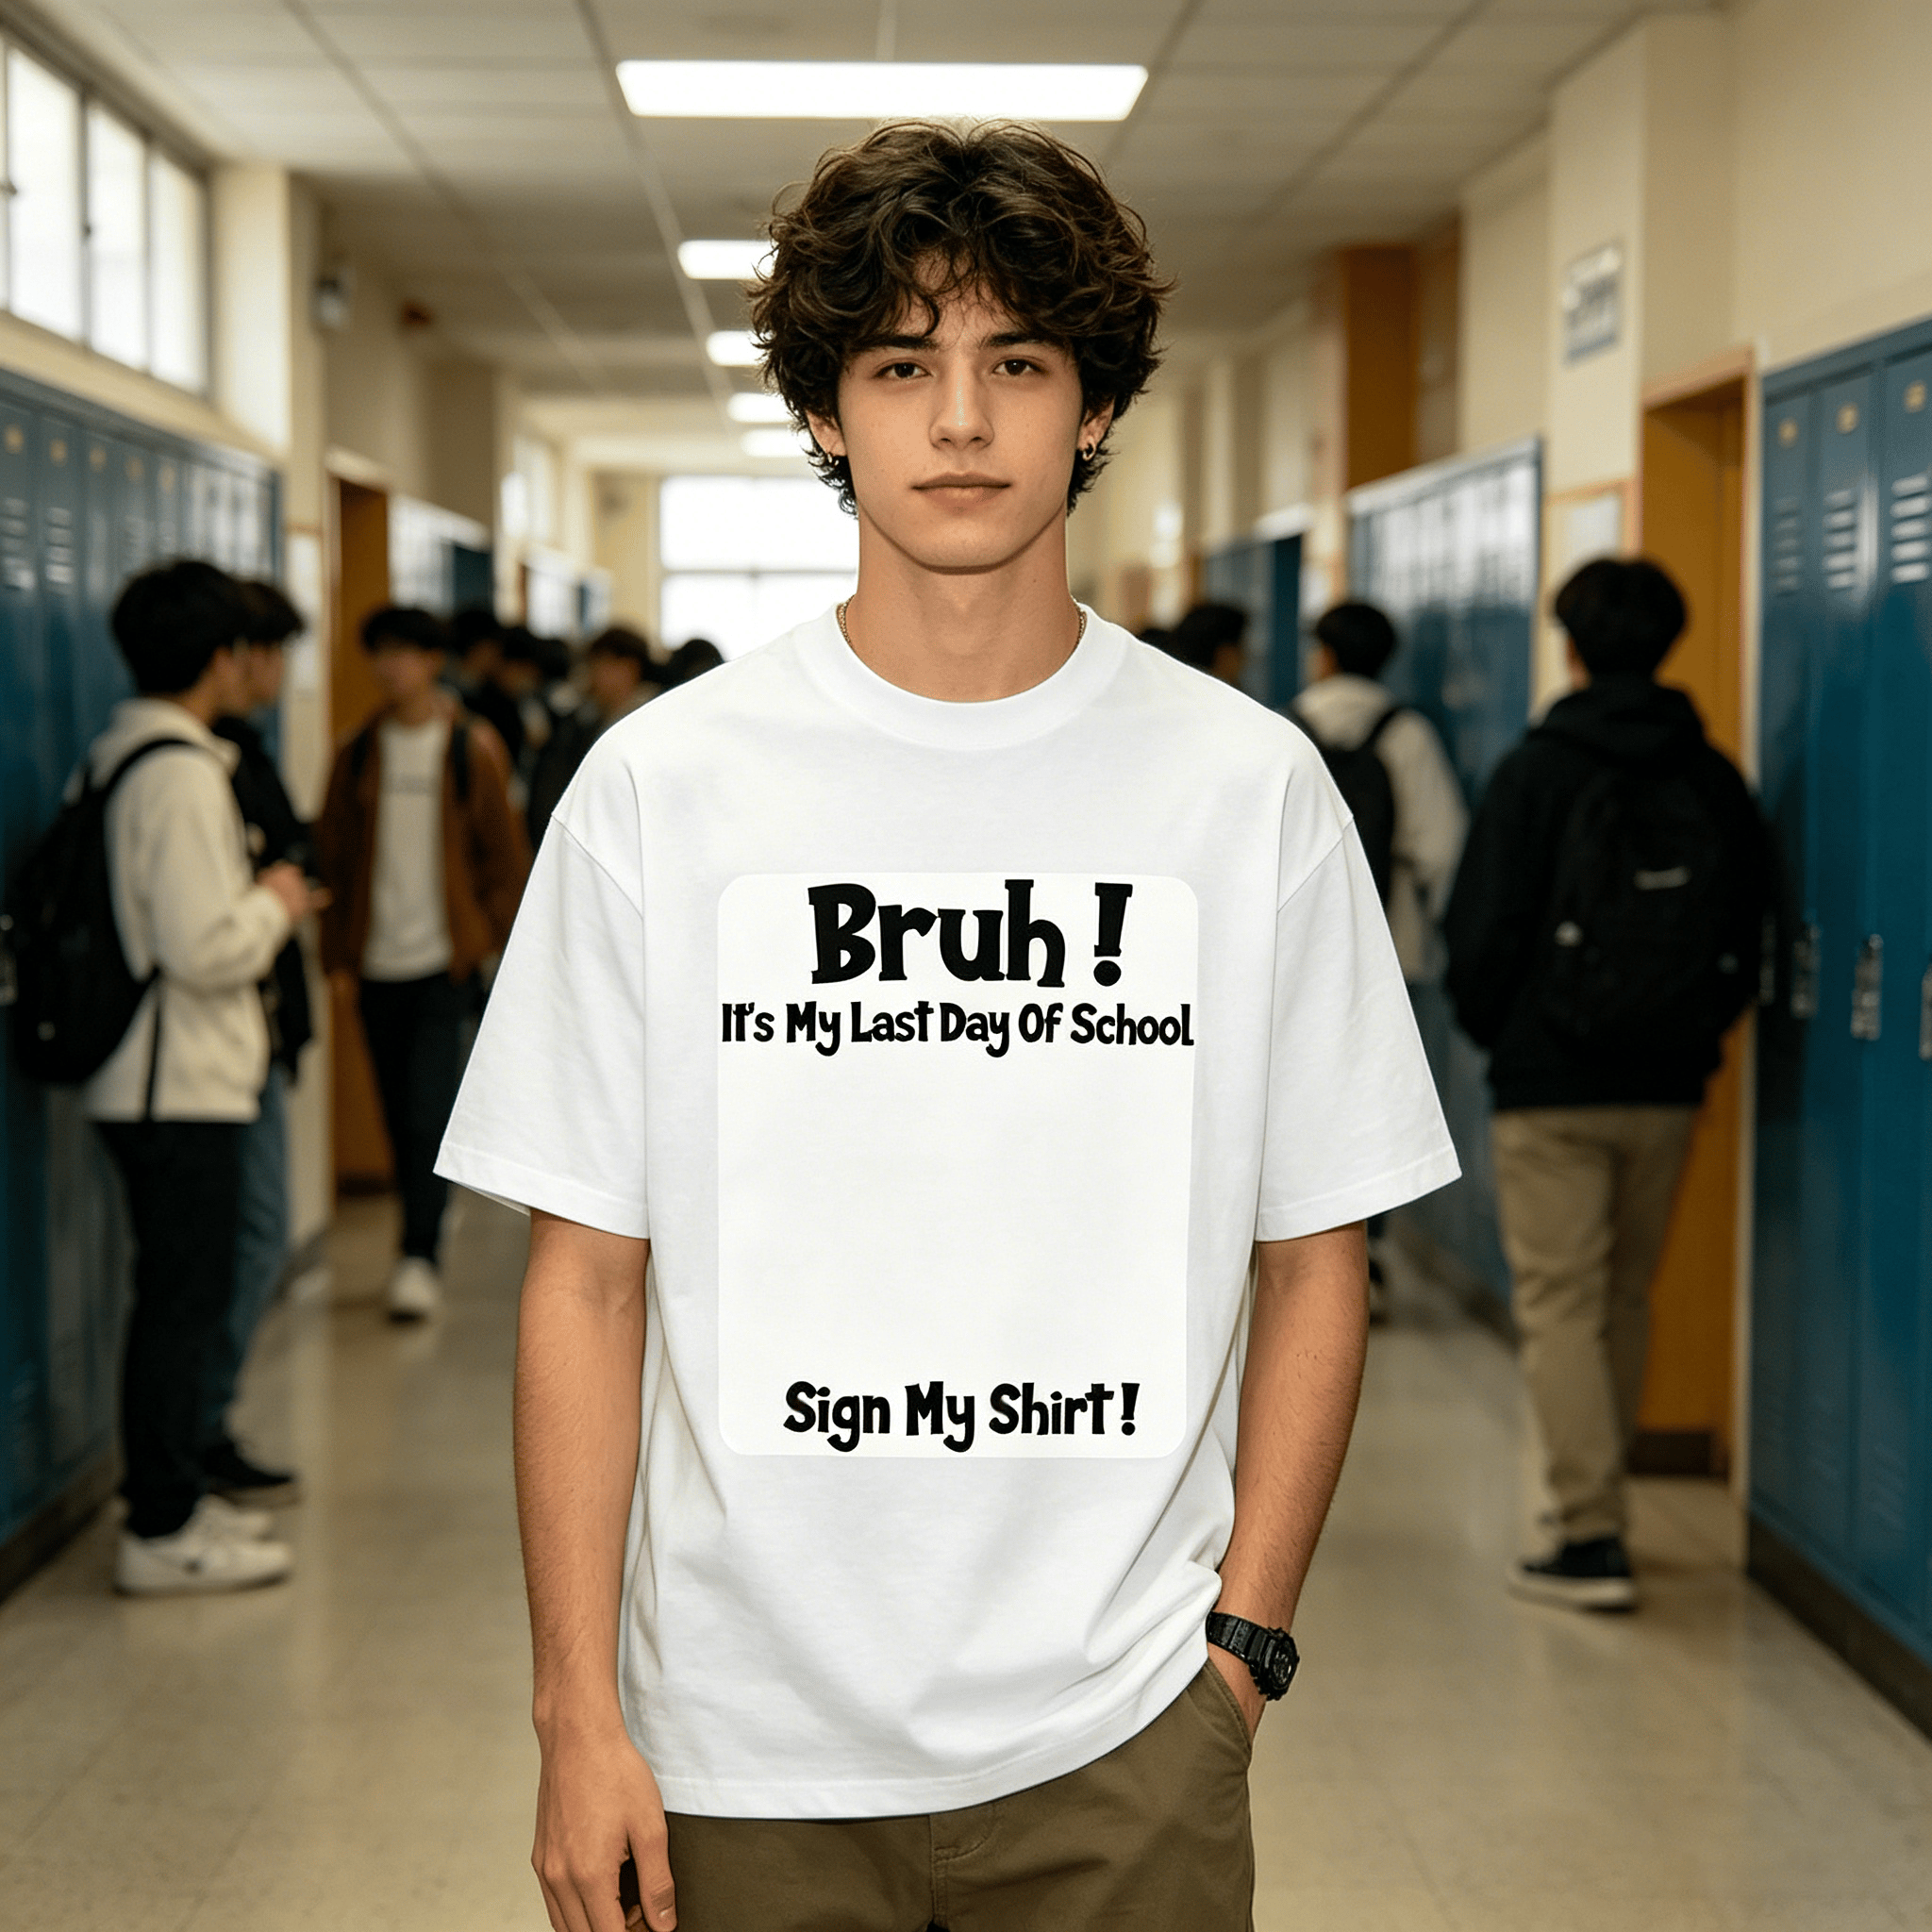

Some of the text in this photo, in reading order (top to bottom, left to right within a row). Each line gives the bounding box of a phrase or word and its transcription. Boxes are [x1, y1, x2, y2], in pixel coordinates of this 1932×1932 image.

[808, 878, 1066, 989] Bruh
[722, 1000, 1195, 1058] It's My Last Day Of School
[783, 1380, 891, 1454] Sign
[904, 1380, 975, 1454] My
